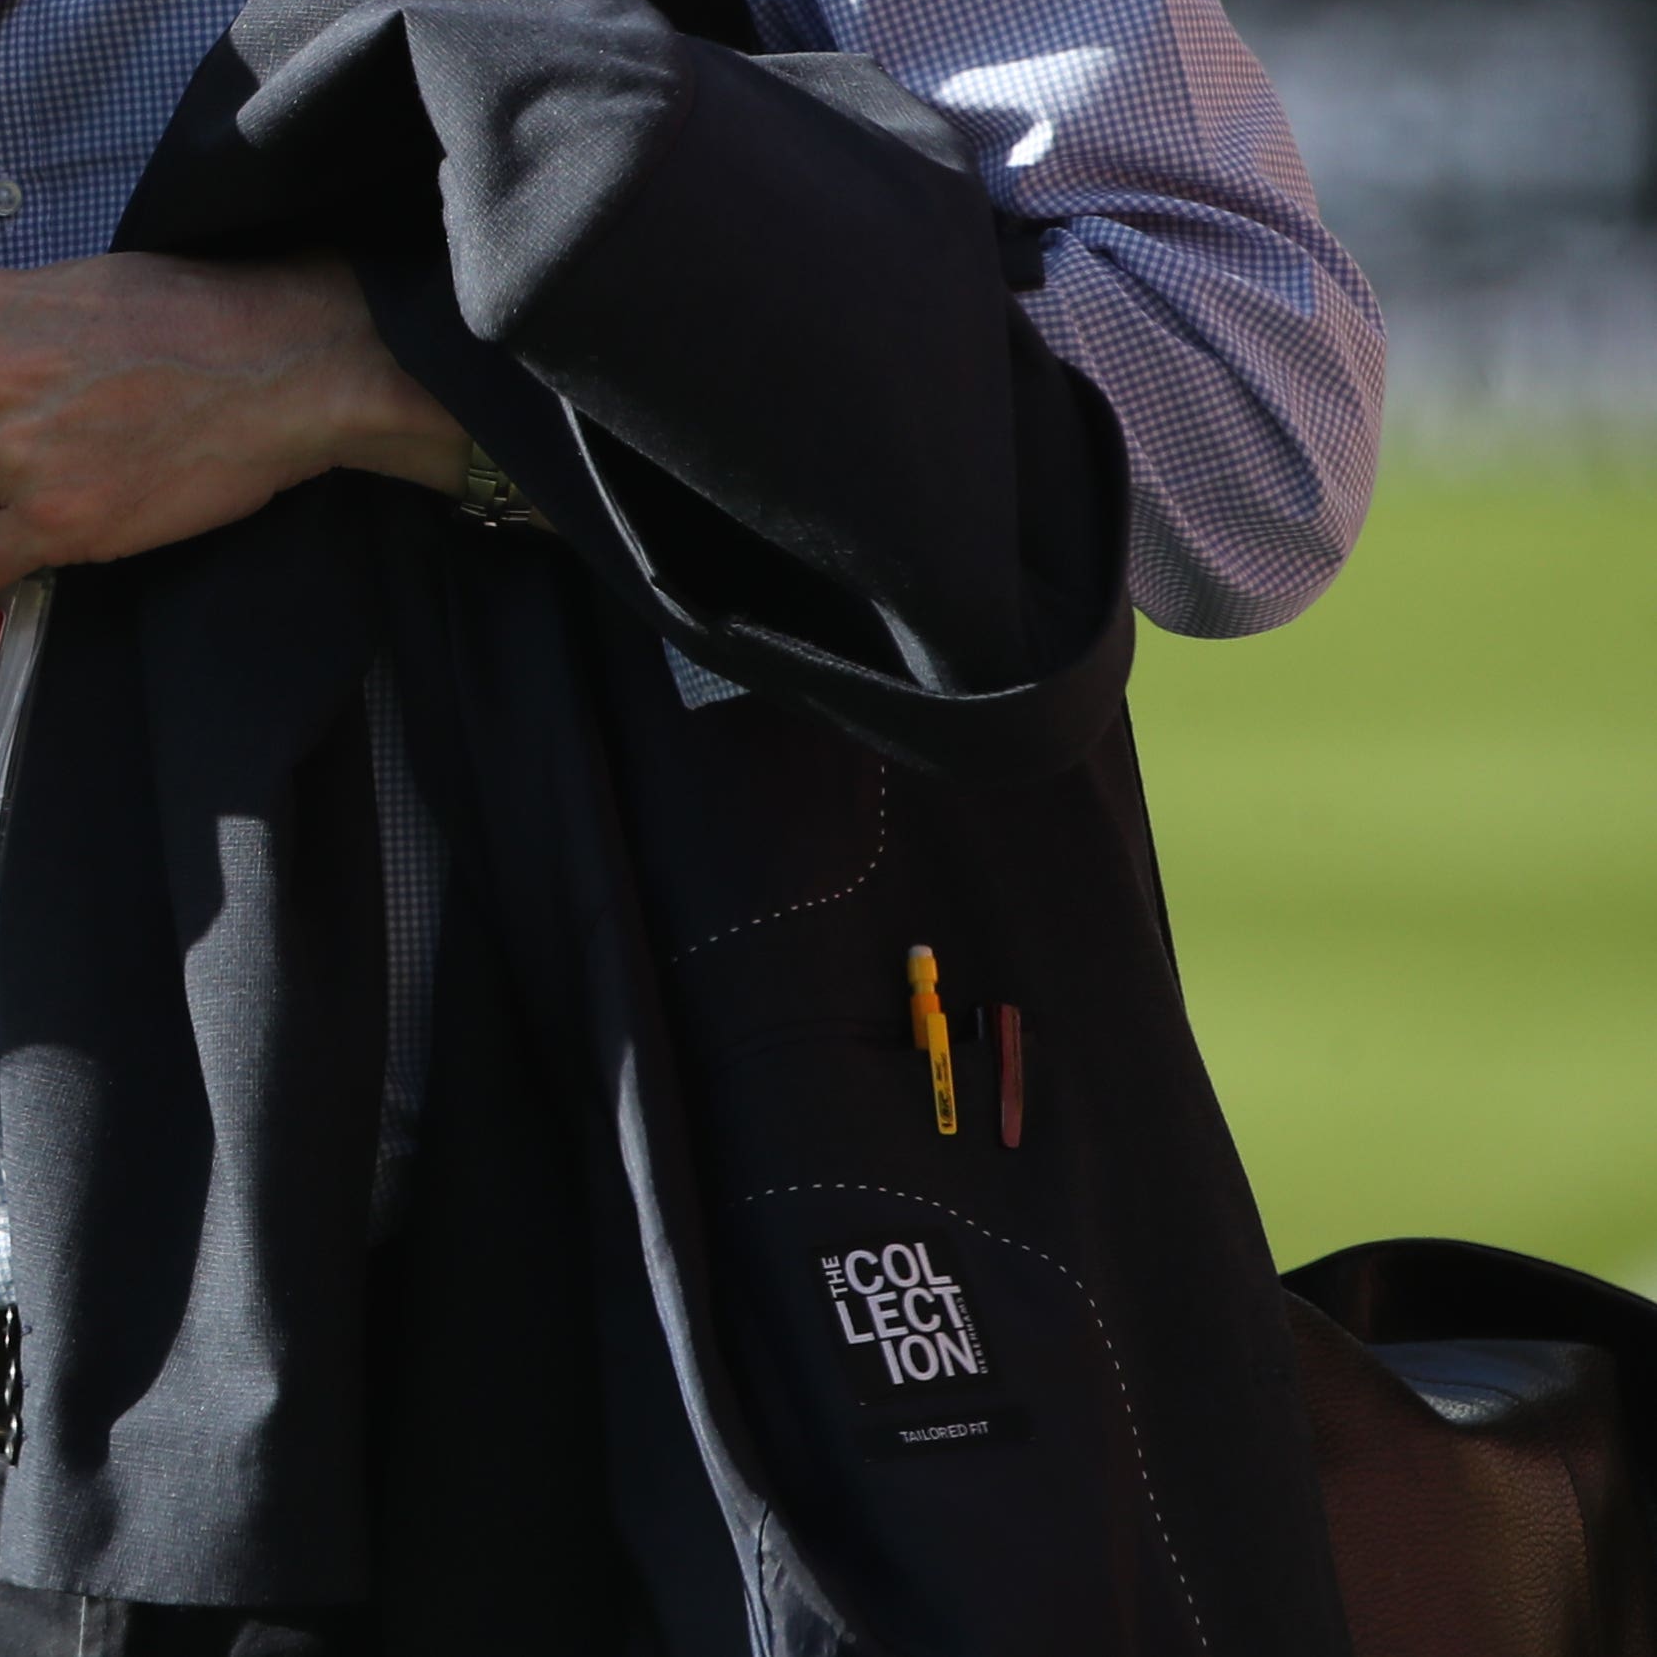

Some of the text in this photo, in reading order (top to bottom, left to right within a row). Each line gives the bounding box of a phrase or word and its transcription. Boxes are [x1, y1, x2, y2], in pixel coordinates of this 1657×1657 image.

[821, 1255, 849, 1299] THE
[844, 1242, 953, 1295] COL
[835, 1285, 965, 1344] LECT
[956, 1296, 989, 1375] DEBENHAMS
[880, 1329, 979, 1385] ION
[899, 1421, 989, 1443] TAILORED FIT
